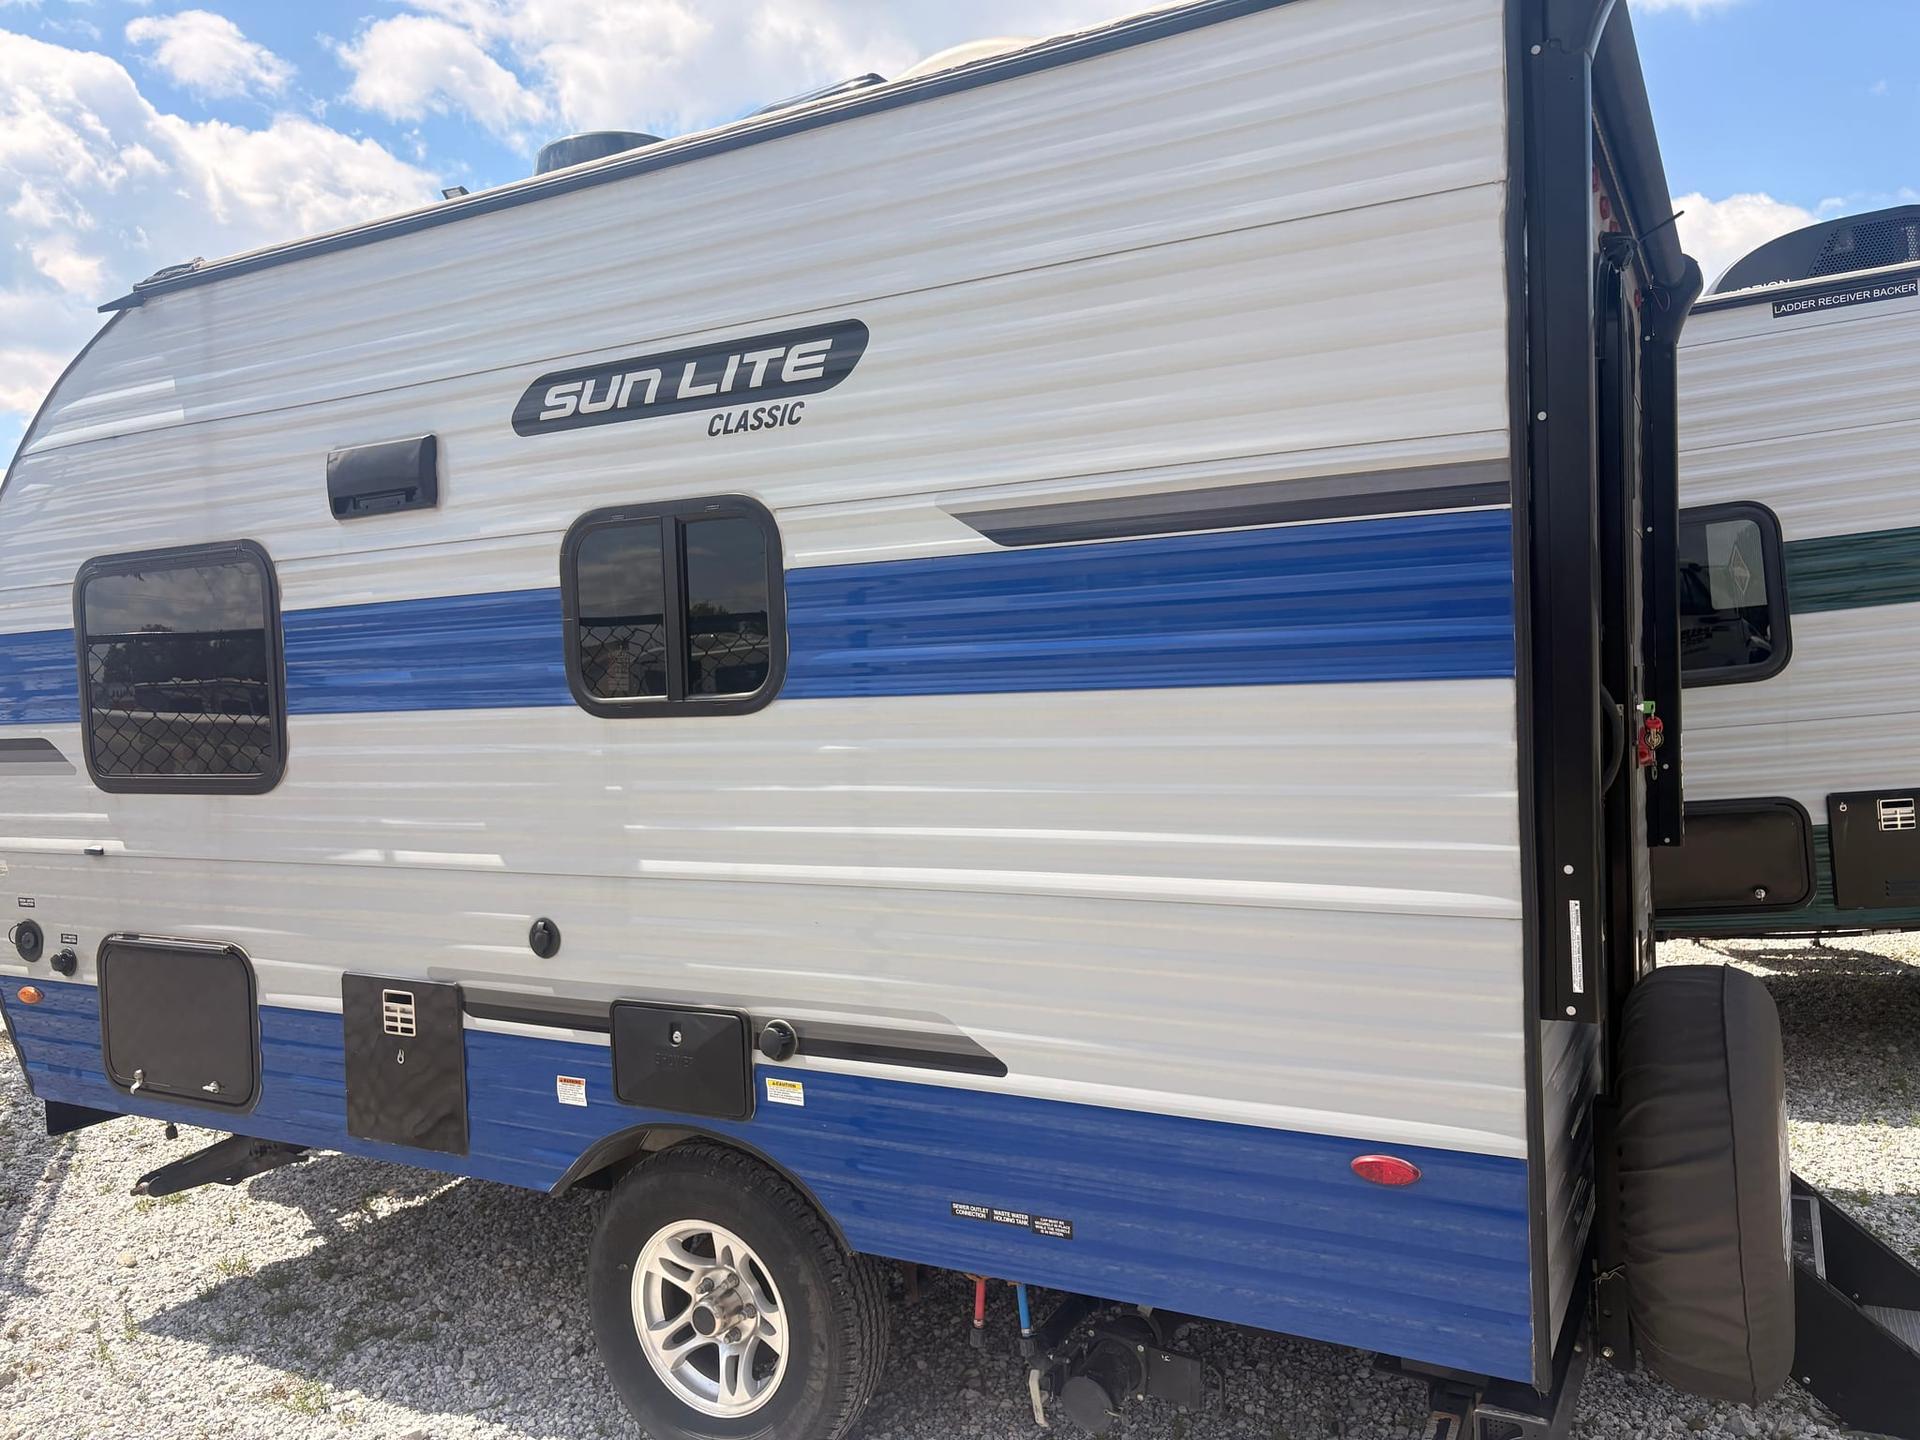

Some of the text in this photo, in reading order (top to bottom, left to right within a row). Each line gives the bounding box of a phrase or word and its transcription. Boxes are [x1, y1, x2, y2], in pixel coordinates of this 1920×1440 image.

[1774, 282, 1916, 314] LADDER RECEIVER BACKER
[539, 338, 833, 421] SUN LITE
[707, 400, 805, 437] CLASSIC
[955, 1209, 986, 1219] CONNECTION
[970, 1205, 989, 1214] OUTLET
[993, 1209, 1029, 1220] WASTE WATER
[994, 1215, 1015, 1224] HOLDING
